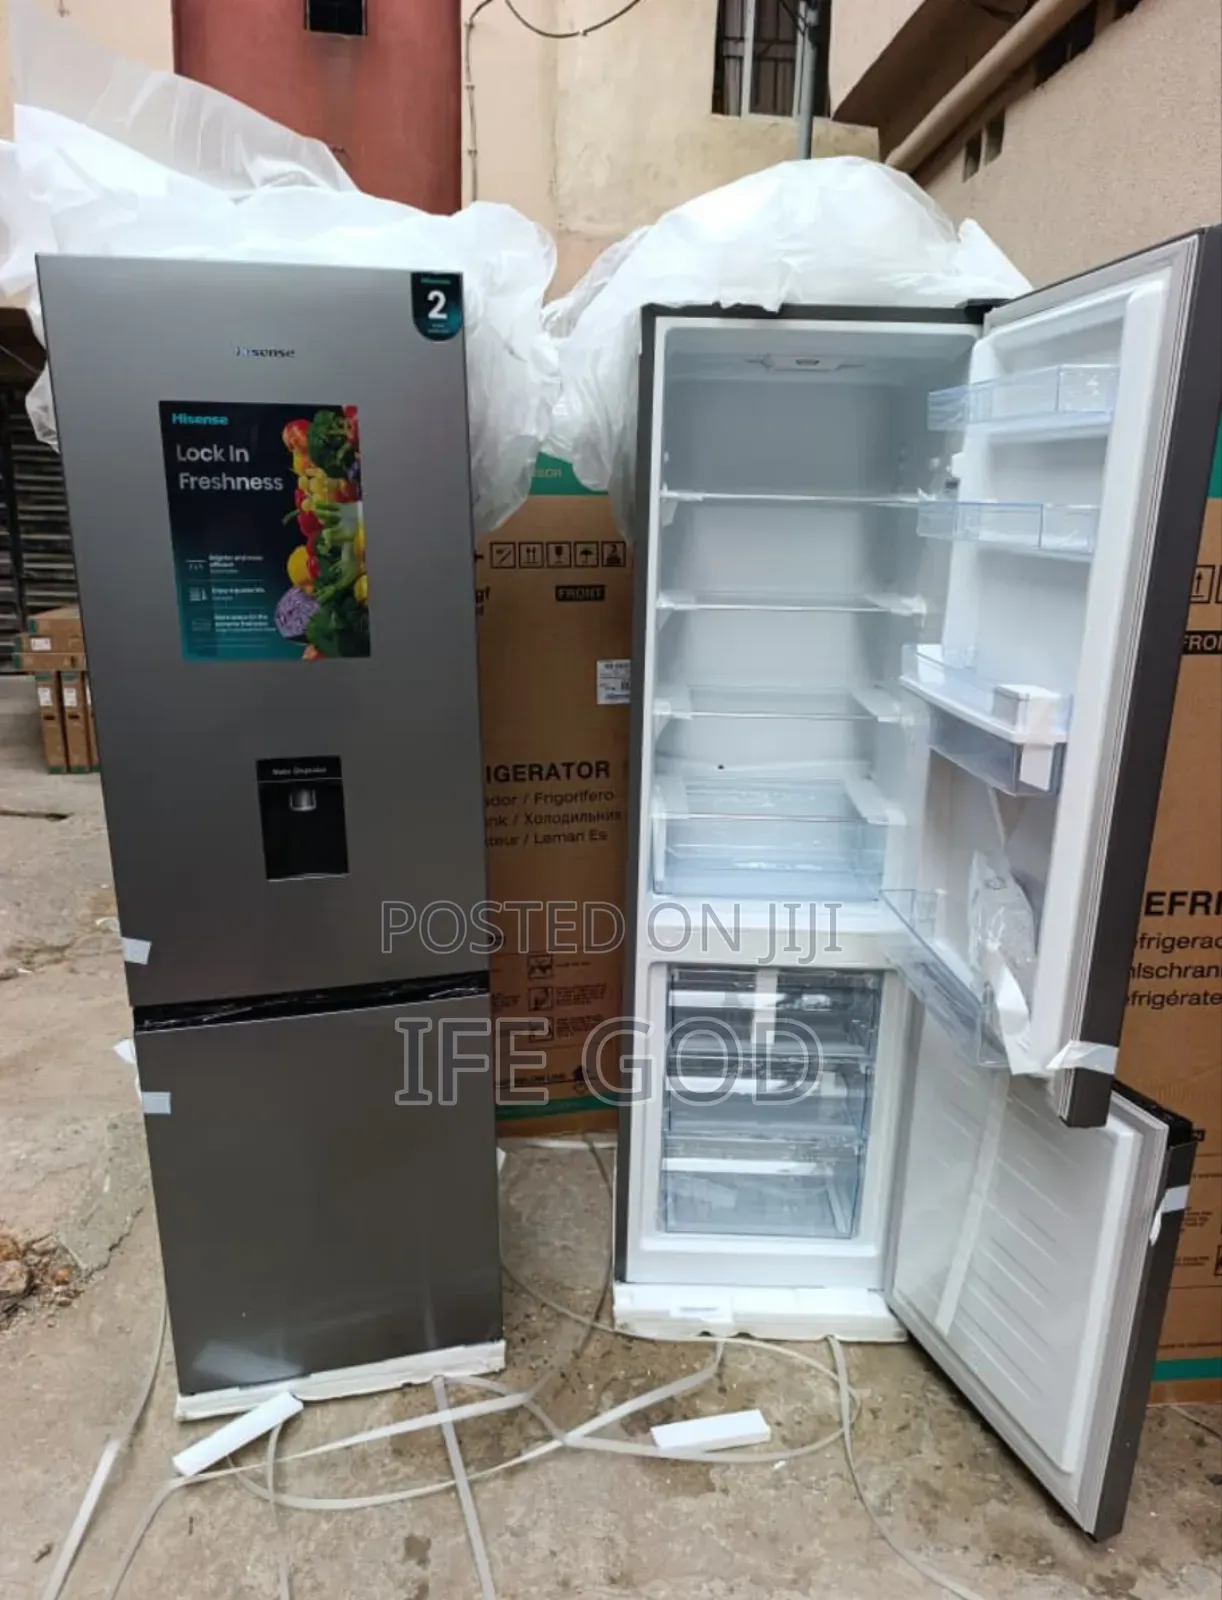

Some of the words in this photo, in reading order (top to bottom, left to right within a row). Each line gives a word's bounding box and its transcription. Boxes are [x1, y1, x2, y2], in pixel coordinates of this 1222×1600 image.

[427, 290, 448, 319] 2
[171, 413, 229, 426] Hisense
[176, 444, 226, 462] Lock
[229, 445, 250, 462] In
[179, 472, 284, 491] Freshness
[558, 587, 602, 601] FRONT
[1184, 634, 1222, 651] RO
[486, 761, 611, 784] IGERATOR
